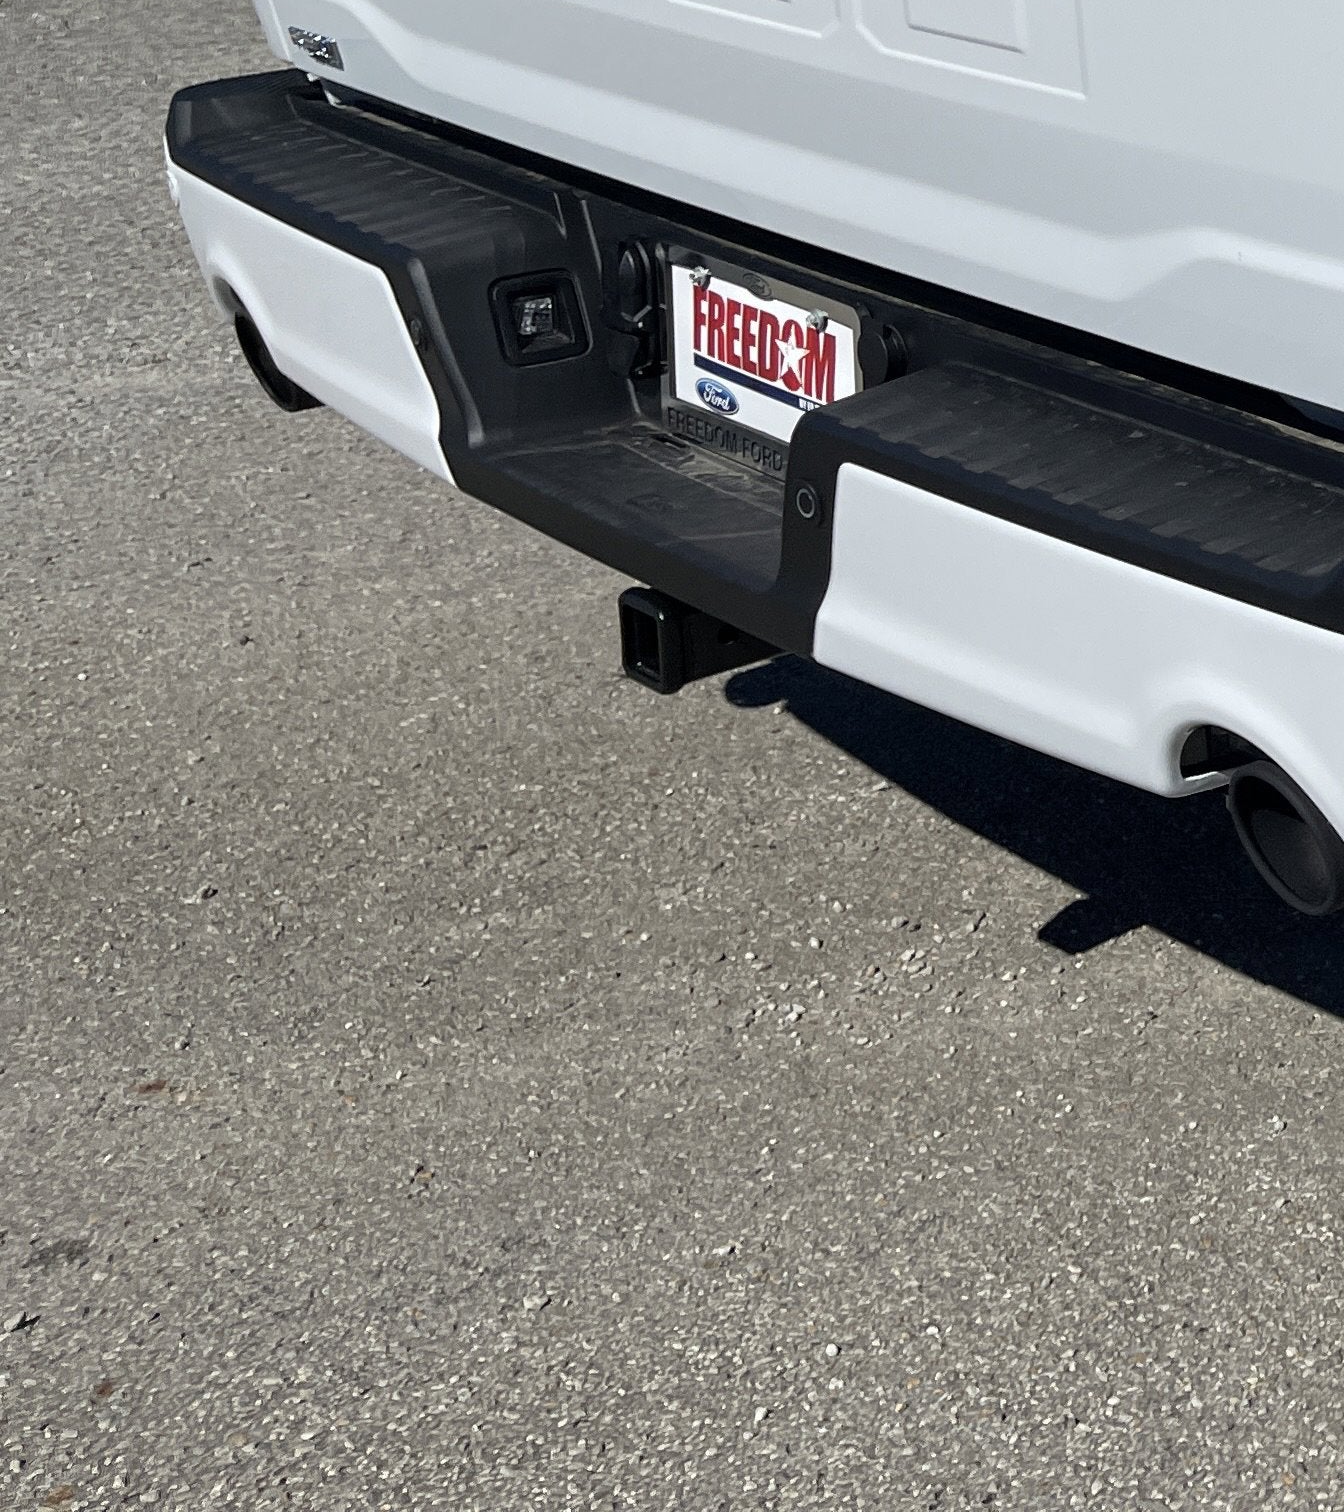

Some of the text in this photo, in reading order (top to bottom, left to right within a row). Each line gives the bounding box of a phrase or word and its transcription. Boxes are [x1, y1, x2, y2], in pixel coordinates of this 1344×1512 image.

[693, 284, 837, 405] FREEDOM
[702, 383, 731, 411] Ford
[667, 406, 783, 472] FREEDOM FORD
